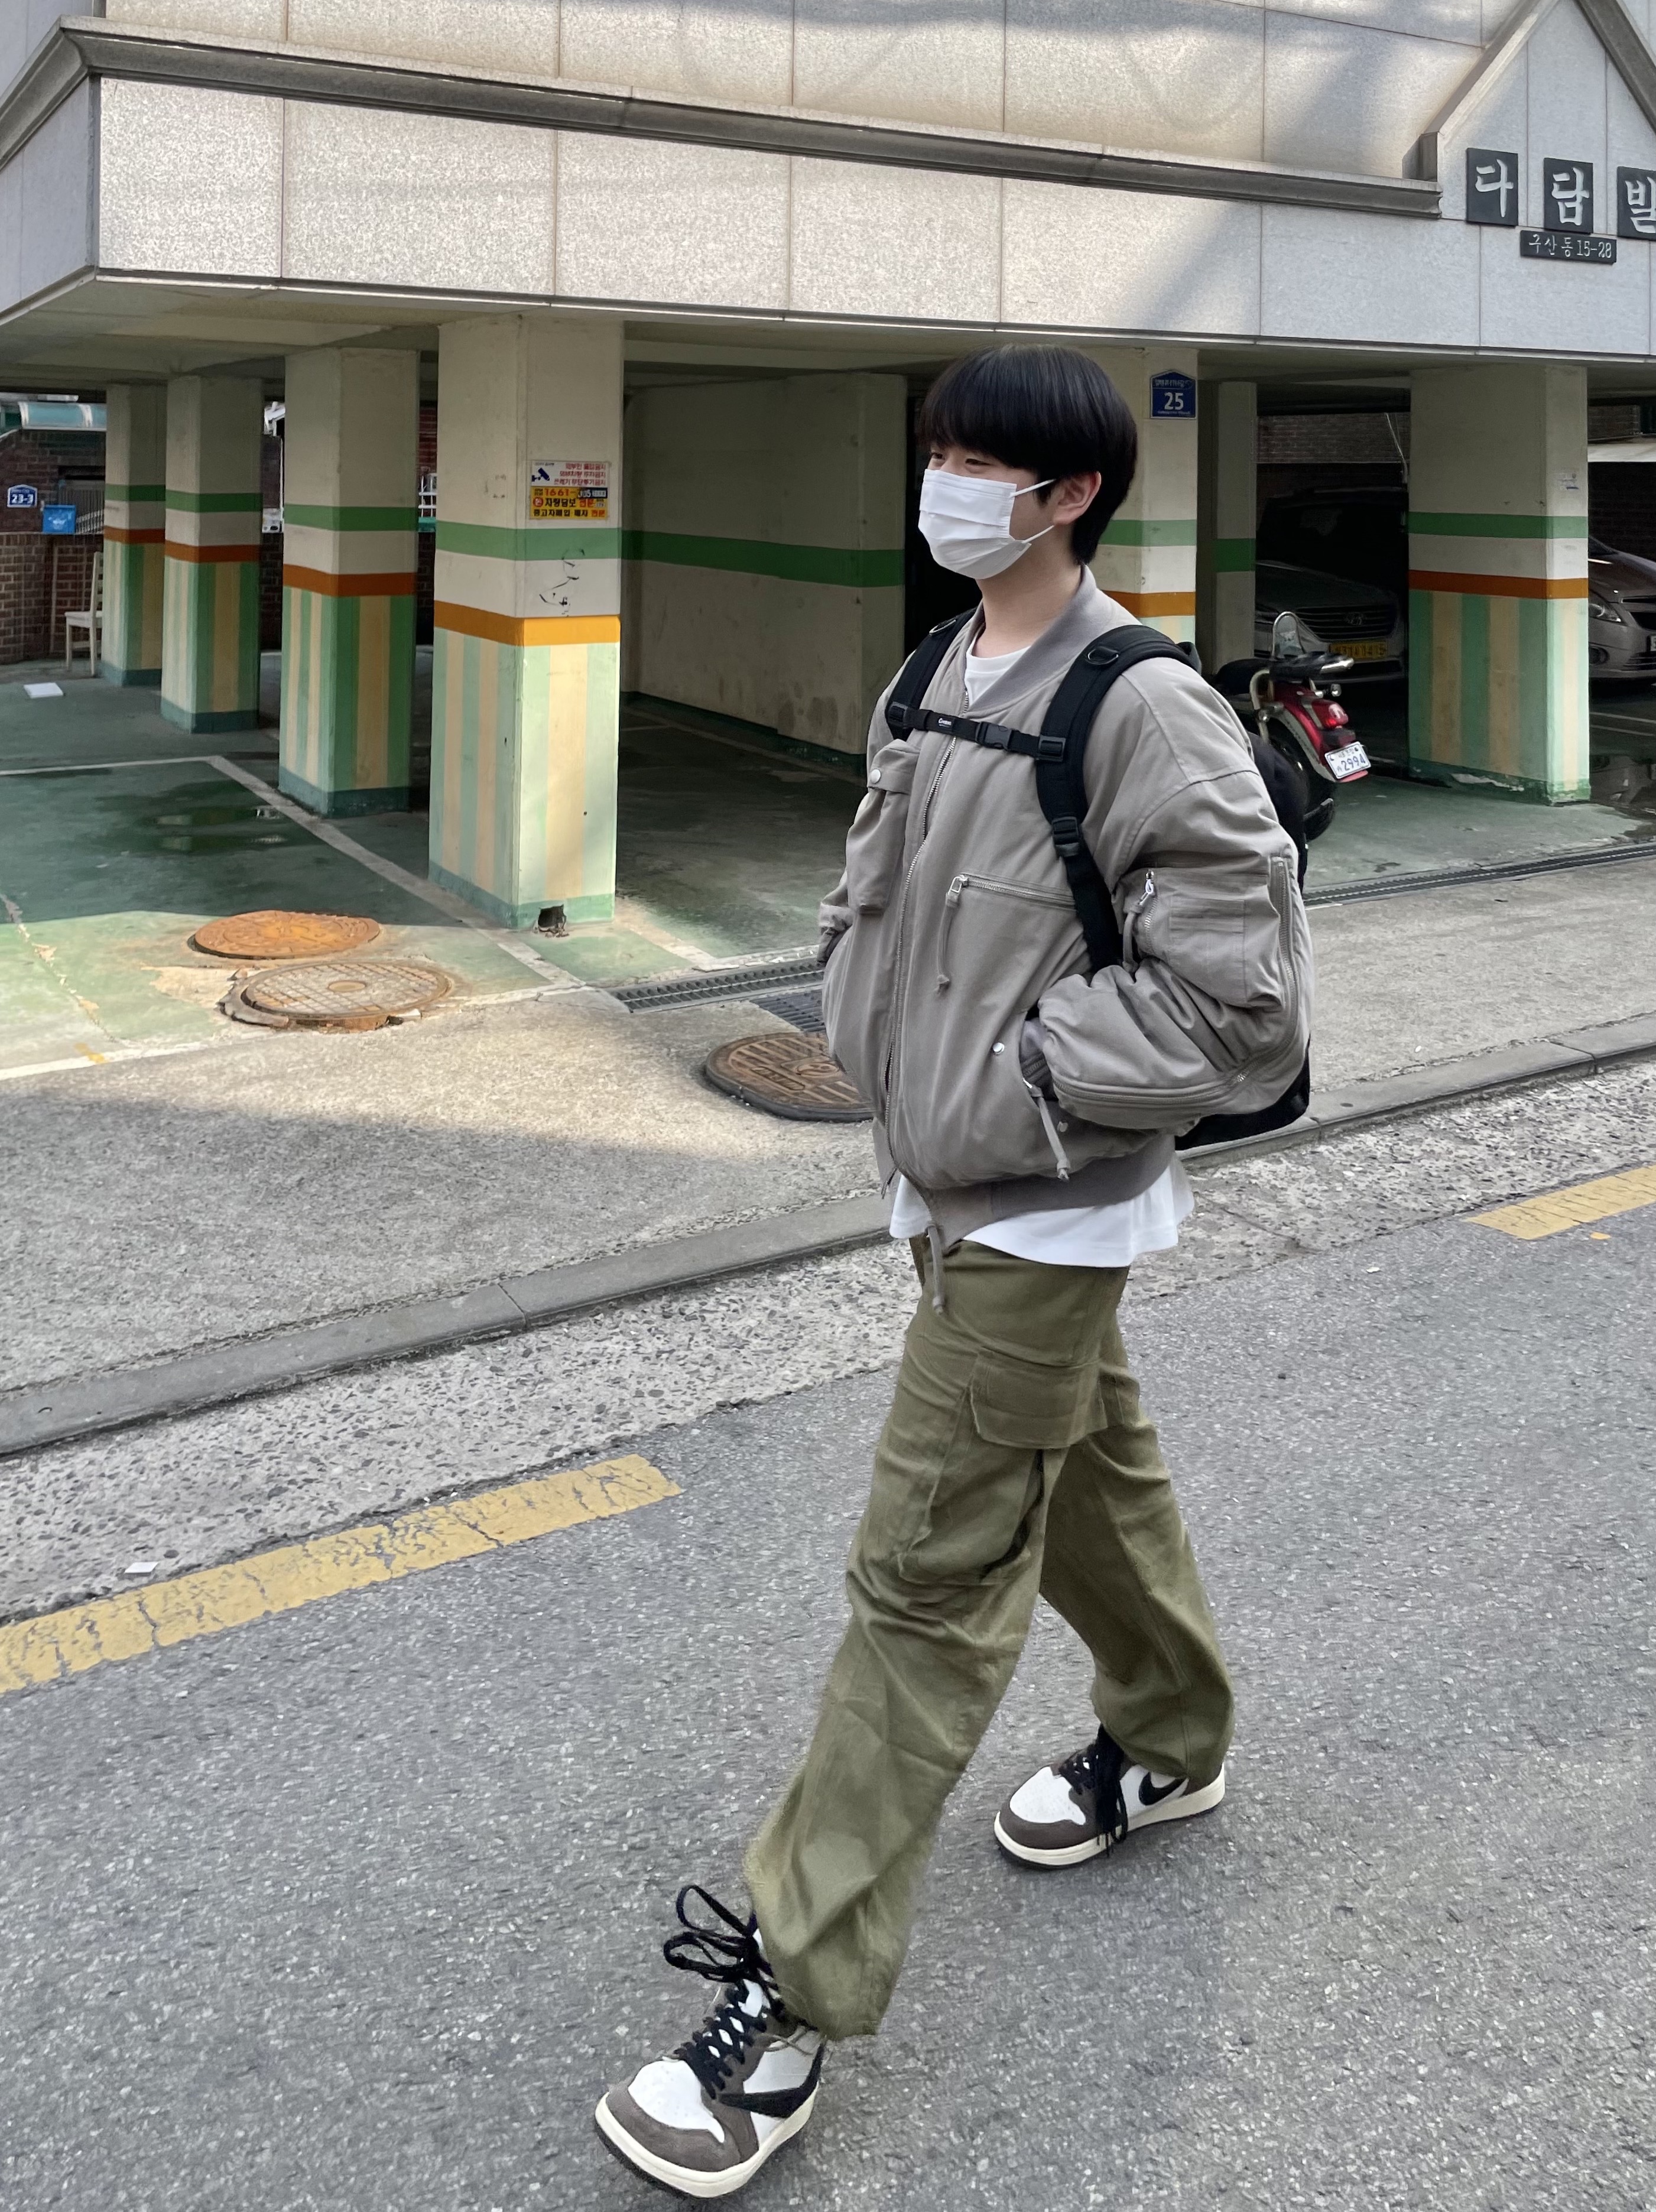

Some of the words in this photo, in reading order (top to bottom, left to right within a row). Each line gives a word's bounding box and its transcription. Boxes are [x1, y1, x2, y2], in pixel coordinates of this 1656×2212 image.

[1528, 233, 1573, 257] 구산동
[1576, 239, 1612, 258] 15-28
[1164, 392, 1184, 410] 25
